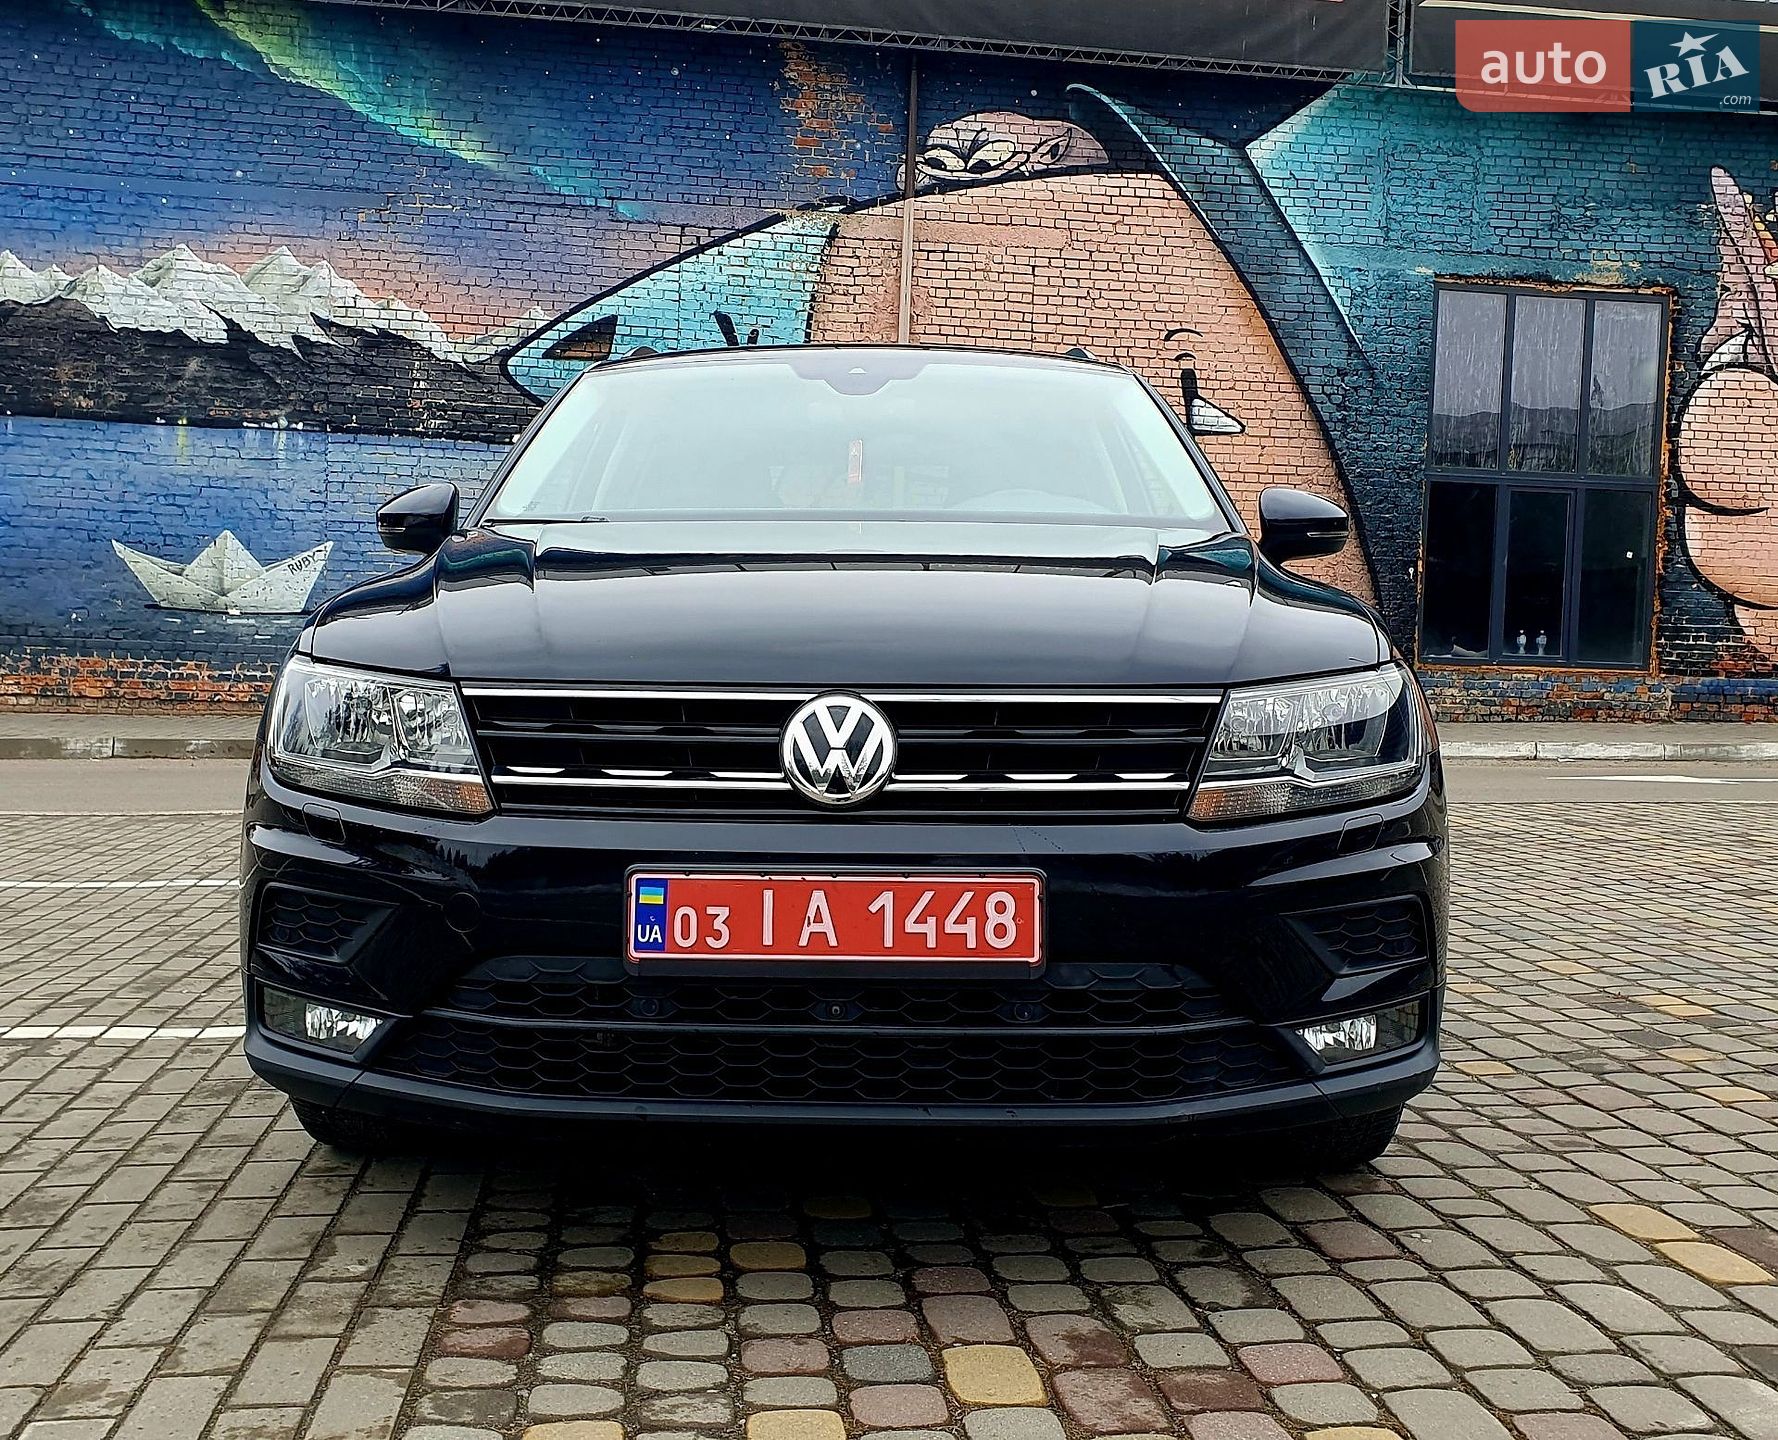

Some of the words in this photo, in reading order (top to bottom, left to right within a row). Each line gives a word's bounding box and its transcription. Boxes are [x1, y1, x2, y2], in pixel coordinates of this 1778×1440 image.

[287, 551, 317, 575] RUBY
[637, 923, 663, 944] UA
[672, 905, 731, 949] 03
